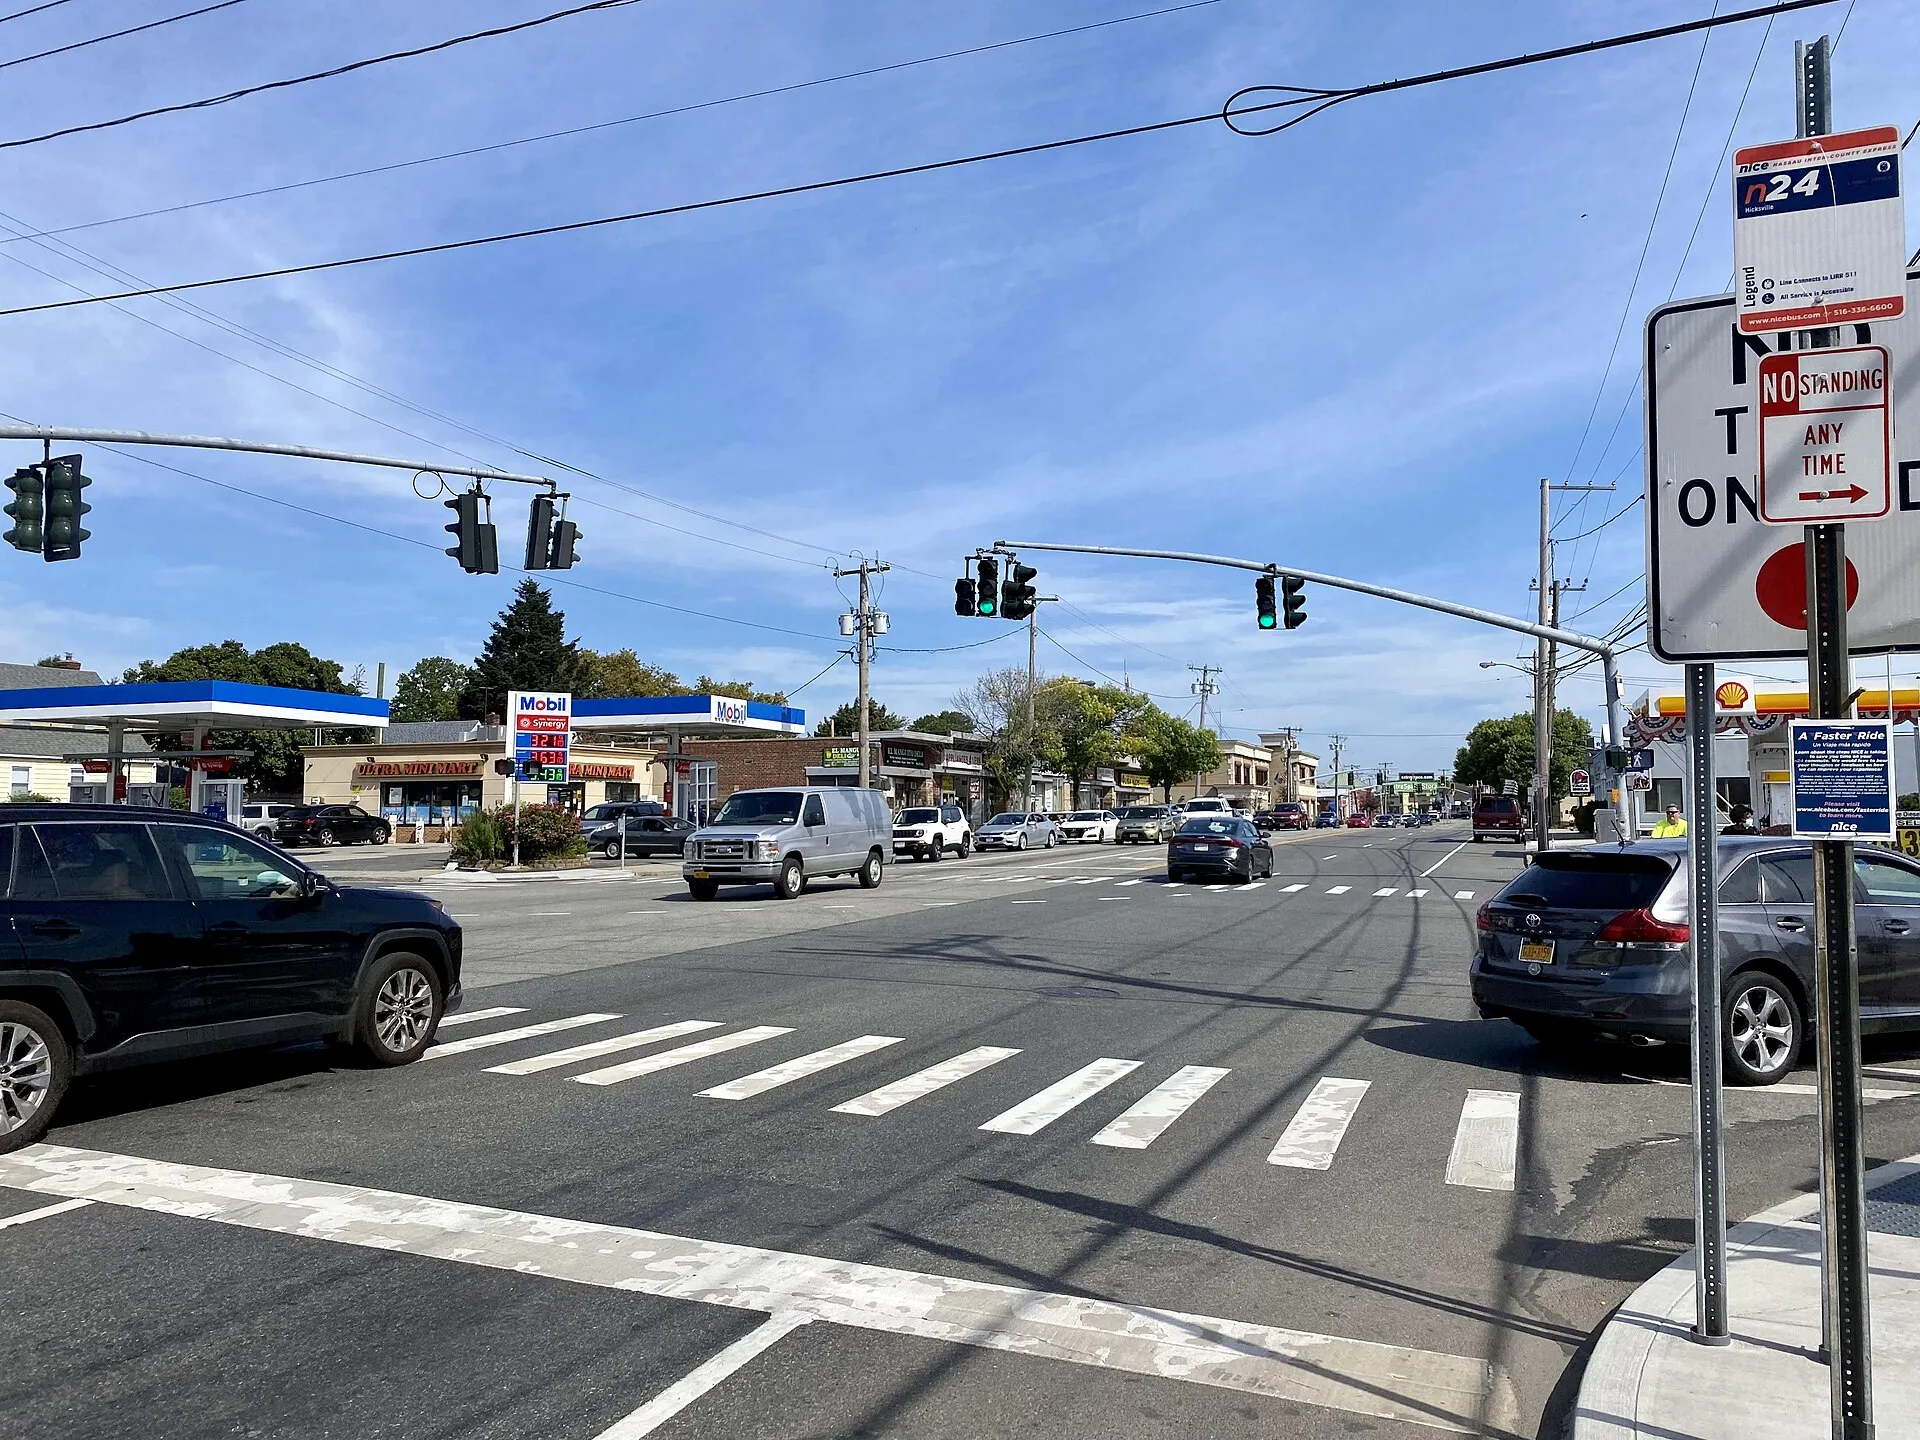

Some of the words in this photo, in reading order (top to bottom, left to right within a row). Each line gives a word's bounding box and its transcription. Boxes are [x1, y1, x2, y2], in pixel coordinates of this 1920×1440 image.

[1740, 162, 1770, 174] nice
[1863, 144, 1897, 154] EXPRESS
[1745, 170, 1820, 204] n24
[1745, 204, 1774, 214] Hicksville
[1743, 266, 1758, 308] Legend
[1821, 286, 1854, 295] Accessible
[1748, 312, 1821, 325] www.nicebus.com
[1834, 303, 1894, 316] 516-336-6600
[1763, 370, 1796, 404] NO
[1800, 368, 1883, 395] STANDING
[1804, 422, 1844, 446] ANY
[1802, 454, 1846, 476] TIME
[520, 697, 566, 711] Mobil
[717, 702, 746, 720] Mobil
[533, 720, 566, 729] Synergy
[1798, 732, 1807, 740] A
[1814, 732, 1852, 740] Faster
[1857, 731, 1885, 740] Ride
[532, 752, 555, 764] 363
[356, 763, 401, 775] ULTRA
[404, 763, 433, 775] MINI
[434, 762, 478, 774] MART
[585, 765, 607, 777] MINI
[608, 766, 634, 778] MART
[1831, 822, 1857, 831] nice
